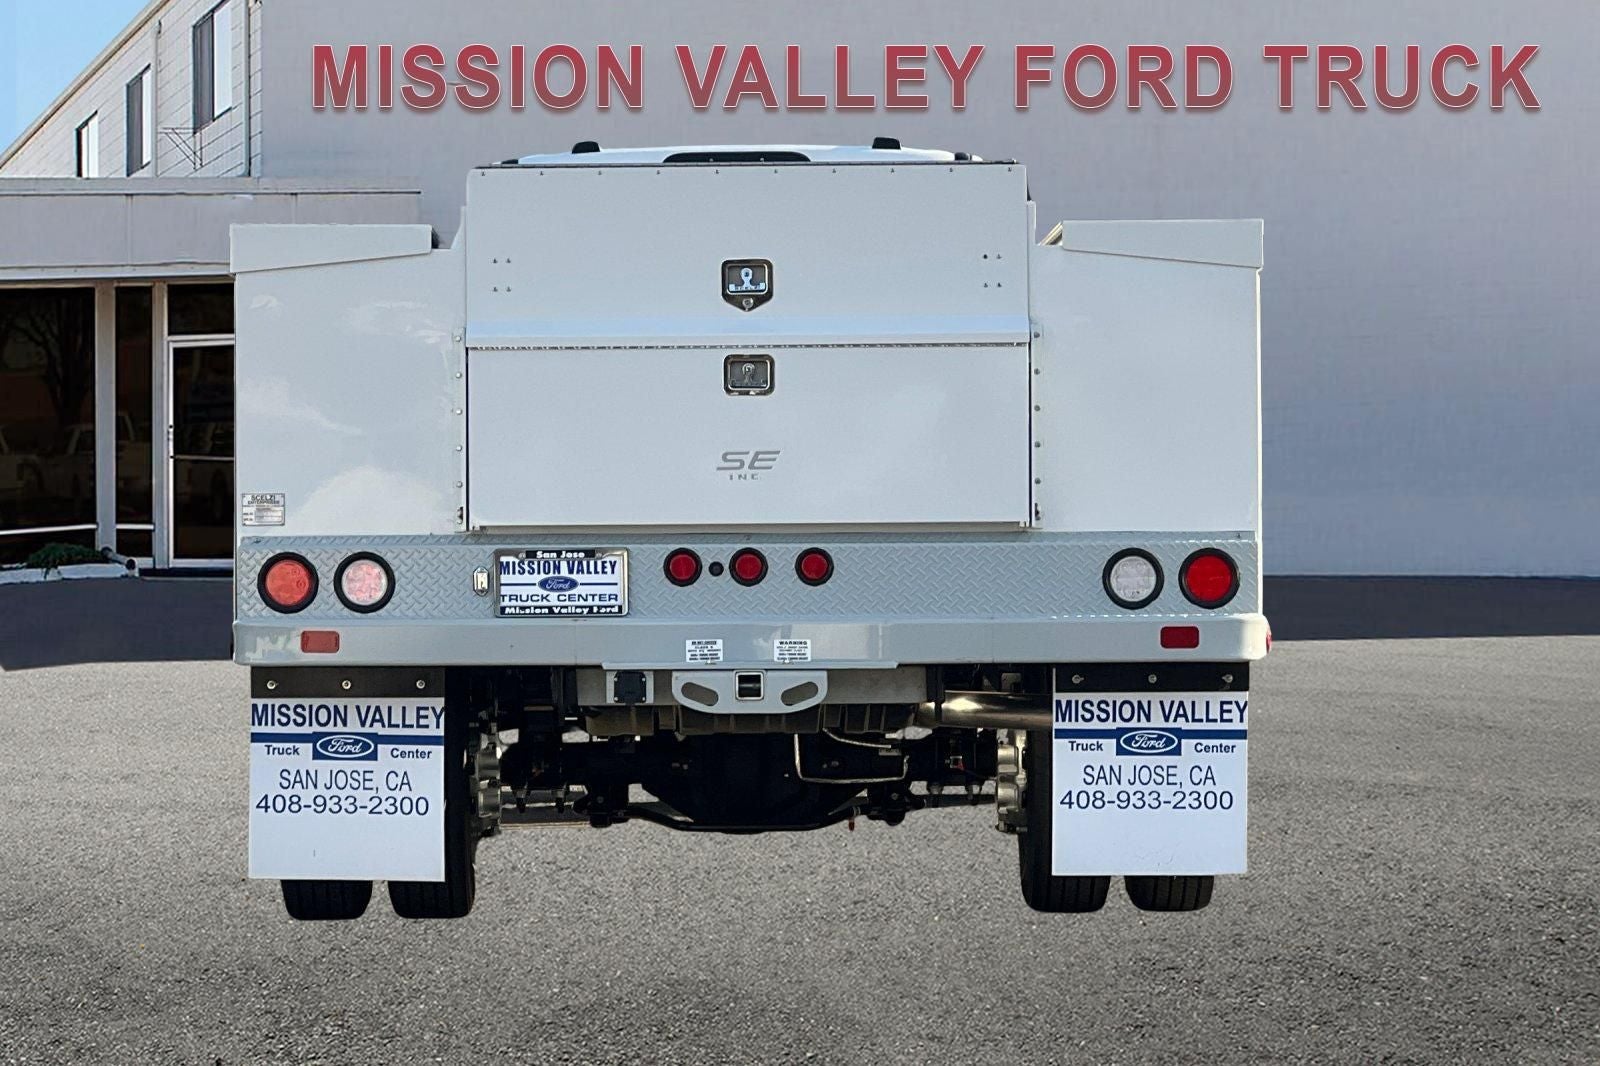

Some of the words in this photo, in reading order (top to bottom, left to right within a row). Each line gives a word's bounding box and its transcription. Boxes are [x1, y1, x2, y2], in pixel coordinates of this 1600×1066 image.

[716, 450, 781, 471] SE
[729, 473, 761, 481] INC
[536, 550, 556, 559] San
[560, 550, 585, 559] Jose
[500, 561, 561, 575] MISSION
[566, 561, 617, 575] VALLEY
[545, 579, 571, 590] Ford
[500, 594, 551, 603] TRUCK
[557, 594, 618, 603] CENTER
[504, 606, 549, 615] Mission
[552, 606, 589, 616] Valley
[593, 606, 619, 614] Ford
[252, 704, 348, 727] MISSION
[355, 705, 444, 729] VALLEY
[1055, 700, 1151, 723] MISSION
[1160, 700, 1248, 723] VALLEY
[328, 739, 362, 754] Ford
[1069, 741, 1104, 752] Truck
[1194, 742, 1236, 753] Center
[1132, 734, 1166, 749] Ford
[265, 745, 300, 756] Truck
[390, 748, 432, 759] Center
[279, 769, 318, 790] SAN
[324, 770, 380, 794] JOSE,
[386, 771, 412, 791] CA
[1083, 765, 1121, 786] SAN
[1128, 765, 1183, 789] JOSE,
[1189, 766, 1216, 786] CA
[256, 794, 429, 815] 408-933-2300
[1060, 790, 1233, 809] 408-933-2300
